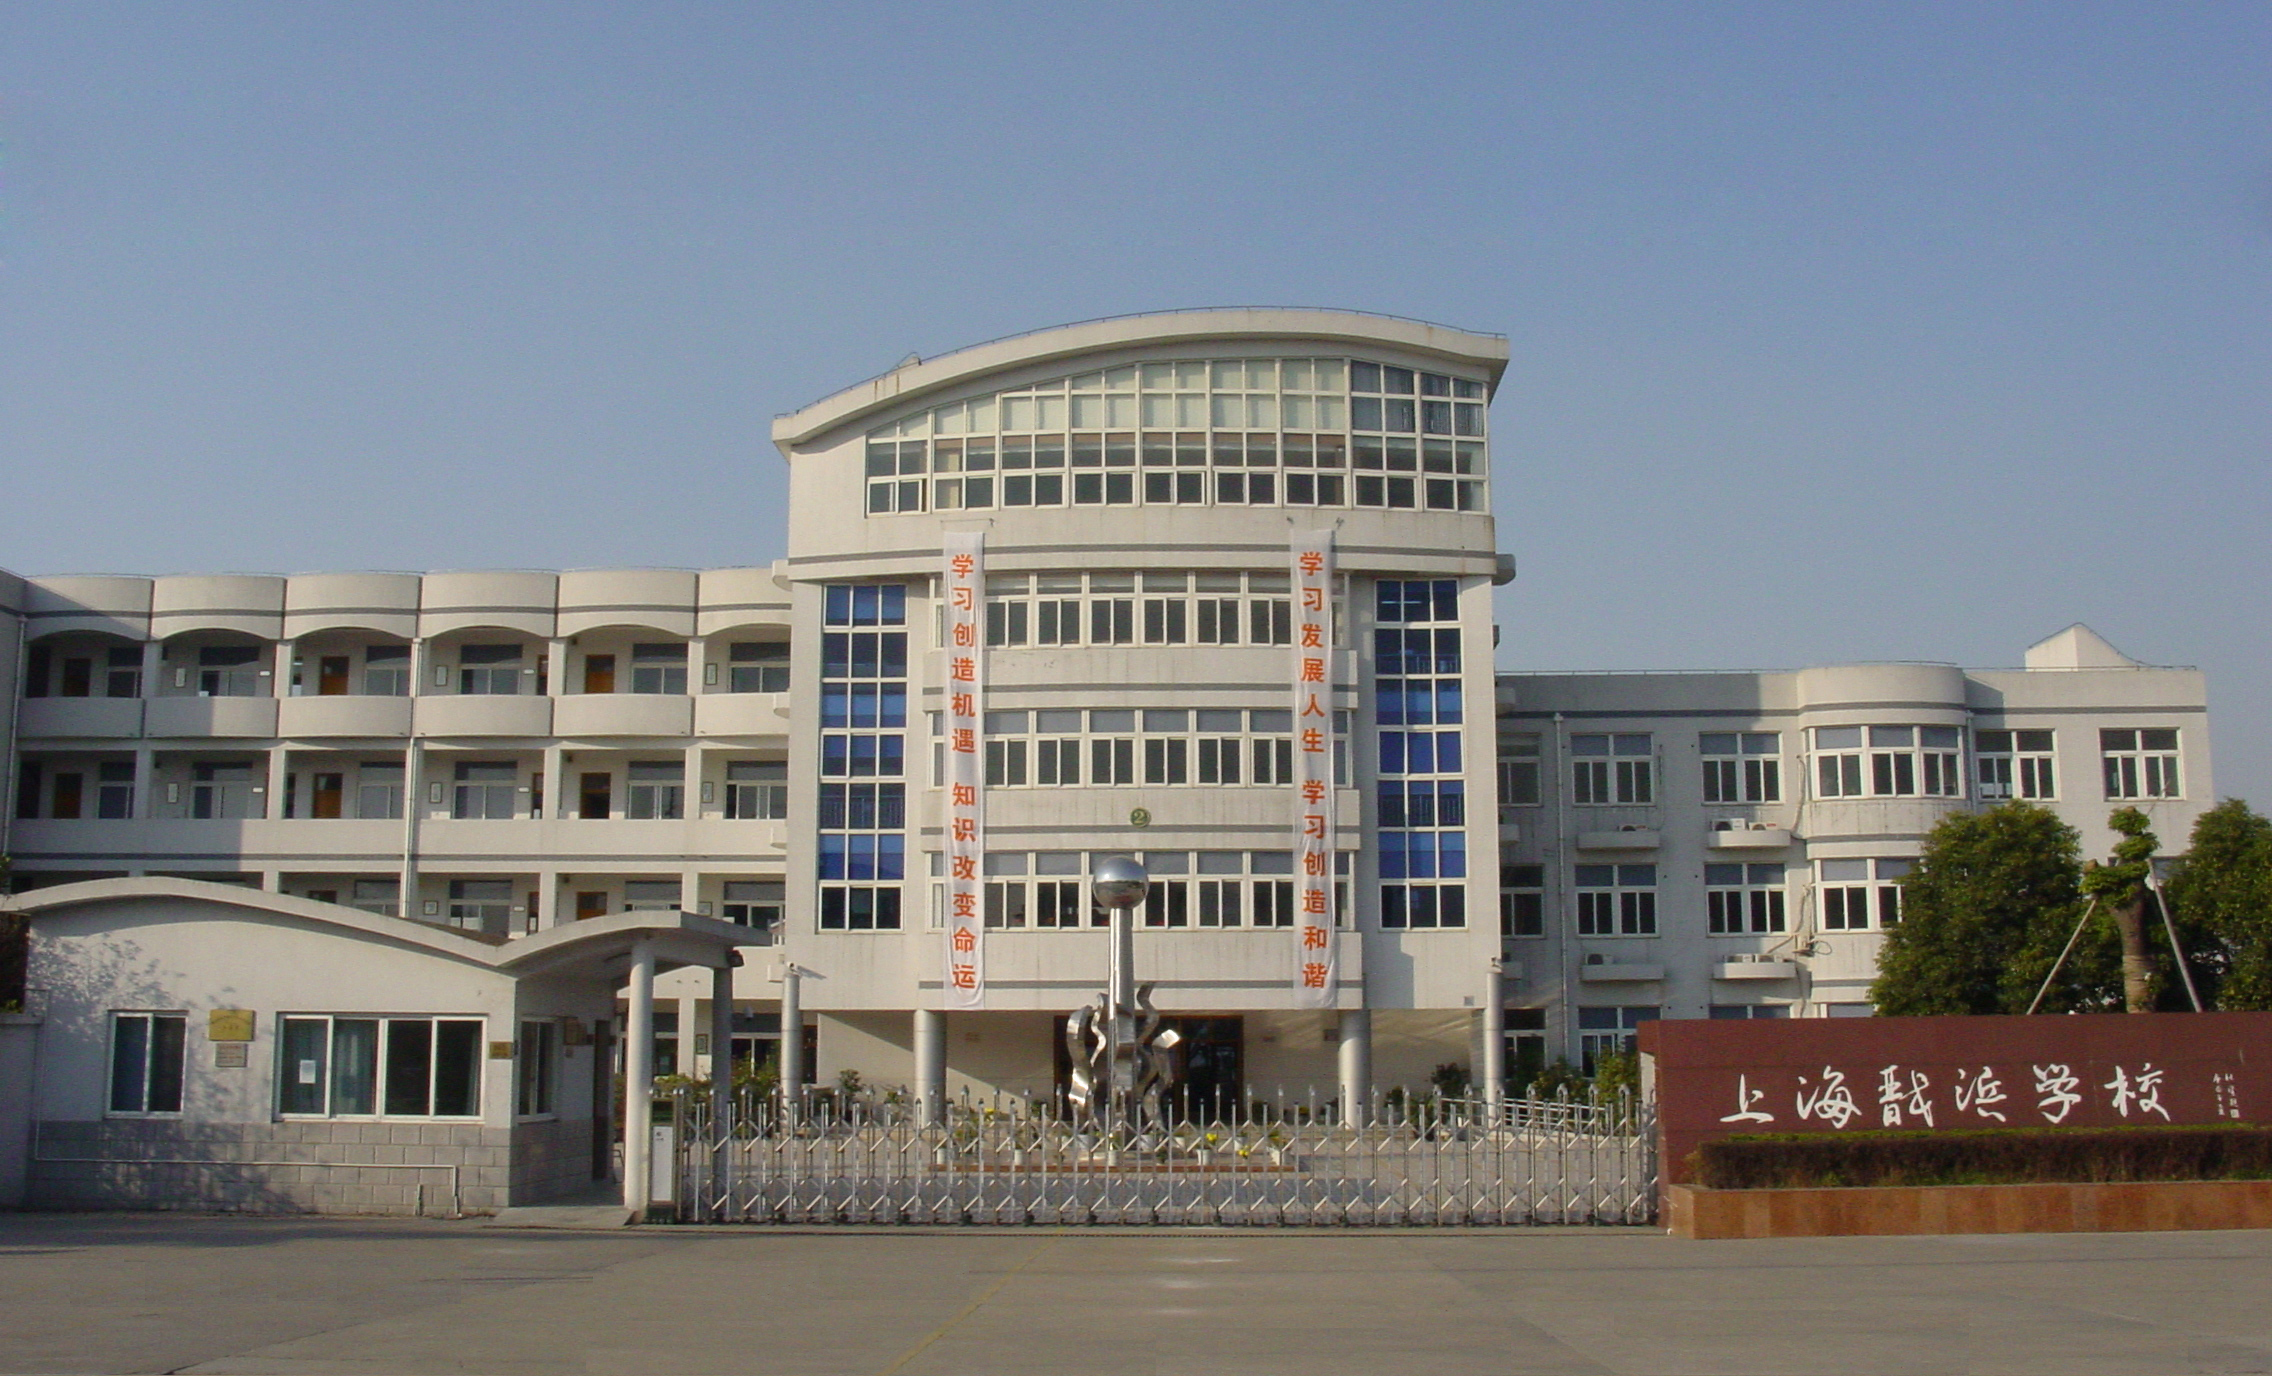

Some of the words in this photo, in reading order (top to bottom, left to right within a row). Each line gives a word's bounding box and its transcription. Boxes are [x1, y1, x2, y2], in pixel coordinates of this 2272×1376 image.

[951, 553, 976, 754] 学习创造机遇
[1299, 551, 1325, 753] 学习发展人生
[951, 782, 977, 989] 知识改变命运
[1301, 780, 1328, 988] 学习创造和谐
